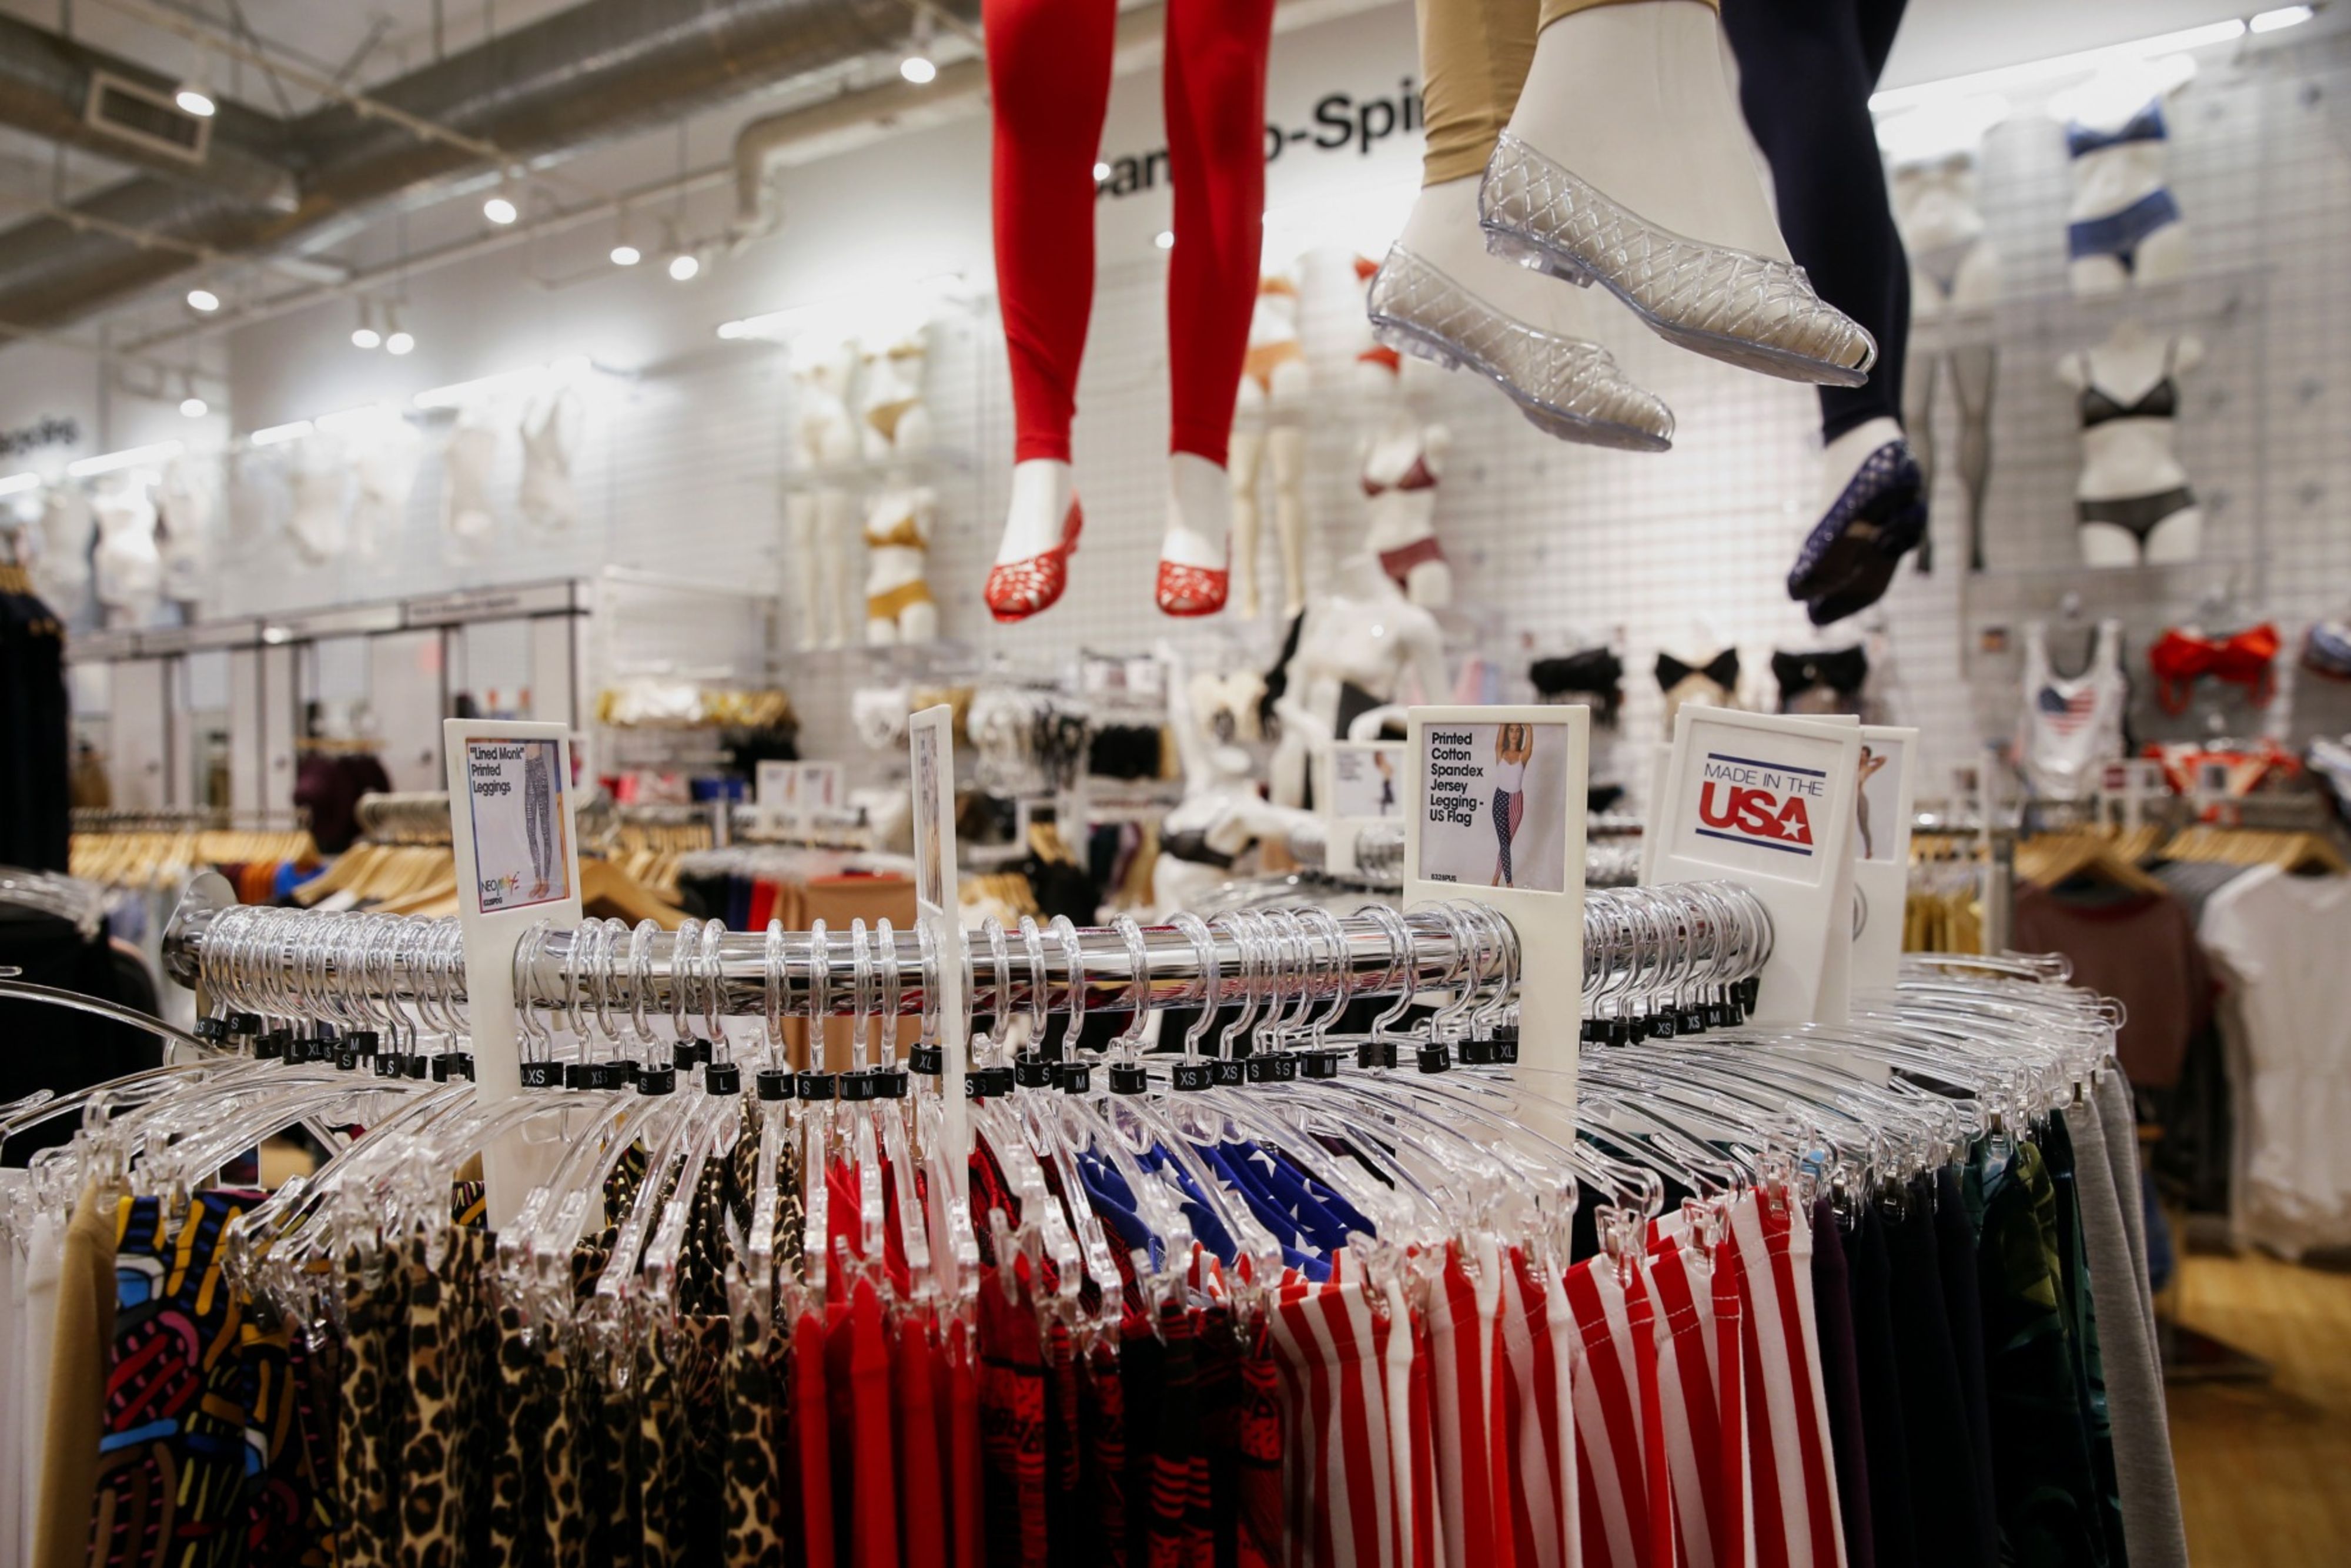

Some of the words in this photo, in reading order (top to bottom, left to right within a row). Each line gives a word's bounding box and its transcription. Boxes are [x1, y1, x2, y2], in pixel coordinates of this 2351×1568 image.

[1432, 733, 1472, 745] Printed
[1432, 748, 1471, 761] Cotton
[471, 764, 501, 776] Printed
[1431, 763, 1483, 778] Spandex
[1430, 778, 1468, 793] Jersey
[1705, 763, 1757, 785] MADE
[1764, 773, 1780, 789] IN
[1787, 777, 1825, 797] THE
[473, 781, 511, 796] Leggings
[1430, 794, 1477, 811] Legging
[1430, 809, 1444, 822] US
[1447, 810, 1472, 827] Flag
[1698, 781, 1813, 845] USA
[230, 1017, 240, 1029] S
[1687, 1015, 1700, 1029] XS
[1710, 1011, 1720, 1024] M
[1656, 1022, 1671, 1035] XS
[307, 1044, 322, 1057] XL
[350, 1037, 360, 1051] M
[1500, 1045, 1515, 1058] XL
[342, 1054, 352, 1066] S
[918, 1054, 934, 1071] XL
[387, 1060, 394, 1075] S
[1018, 1067, 1025, 1082] S
[1042, 1067, 1050, 1081] S
[1221, 1065, 1238, 1079] XS
[1251, 1064, 1259, 1078] S
[1282, 1062, 1291, 1076] S
[528, 1069, 546, 1085] XS
[640, 1078, 648, 1091] S
[666, 1076, 673, 1089] S
[720, 1076, 728, 1091] L
[1075, 1075, 1086, 1089] M
[1136, 1075, 1143, 1089] L
[1180, 1071, 1197, 1086] XS
[780, 1078, 788, 1092] L
[803, 1081, 811, 1095] S
[862, 1080, 874, 1096] M
[897, 1079, 903, 1094] L
